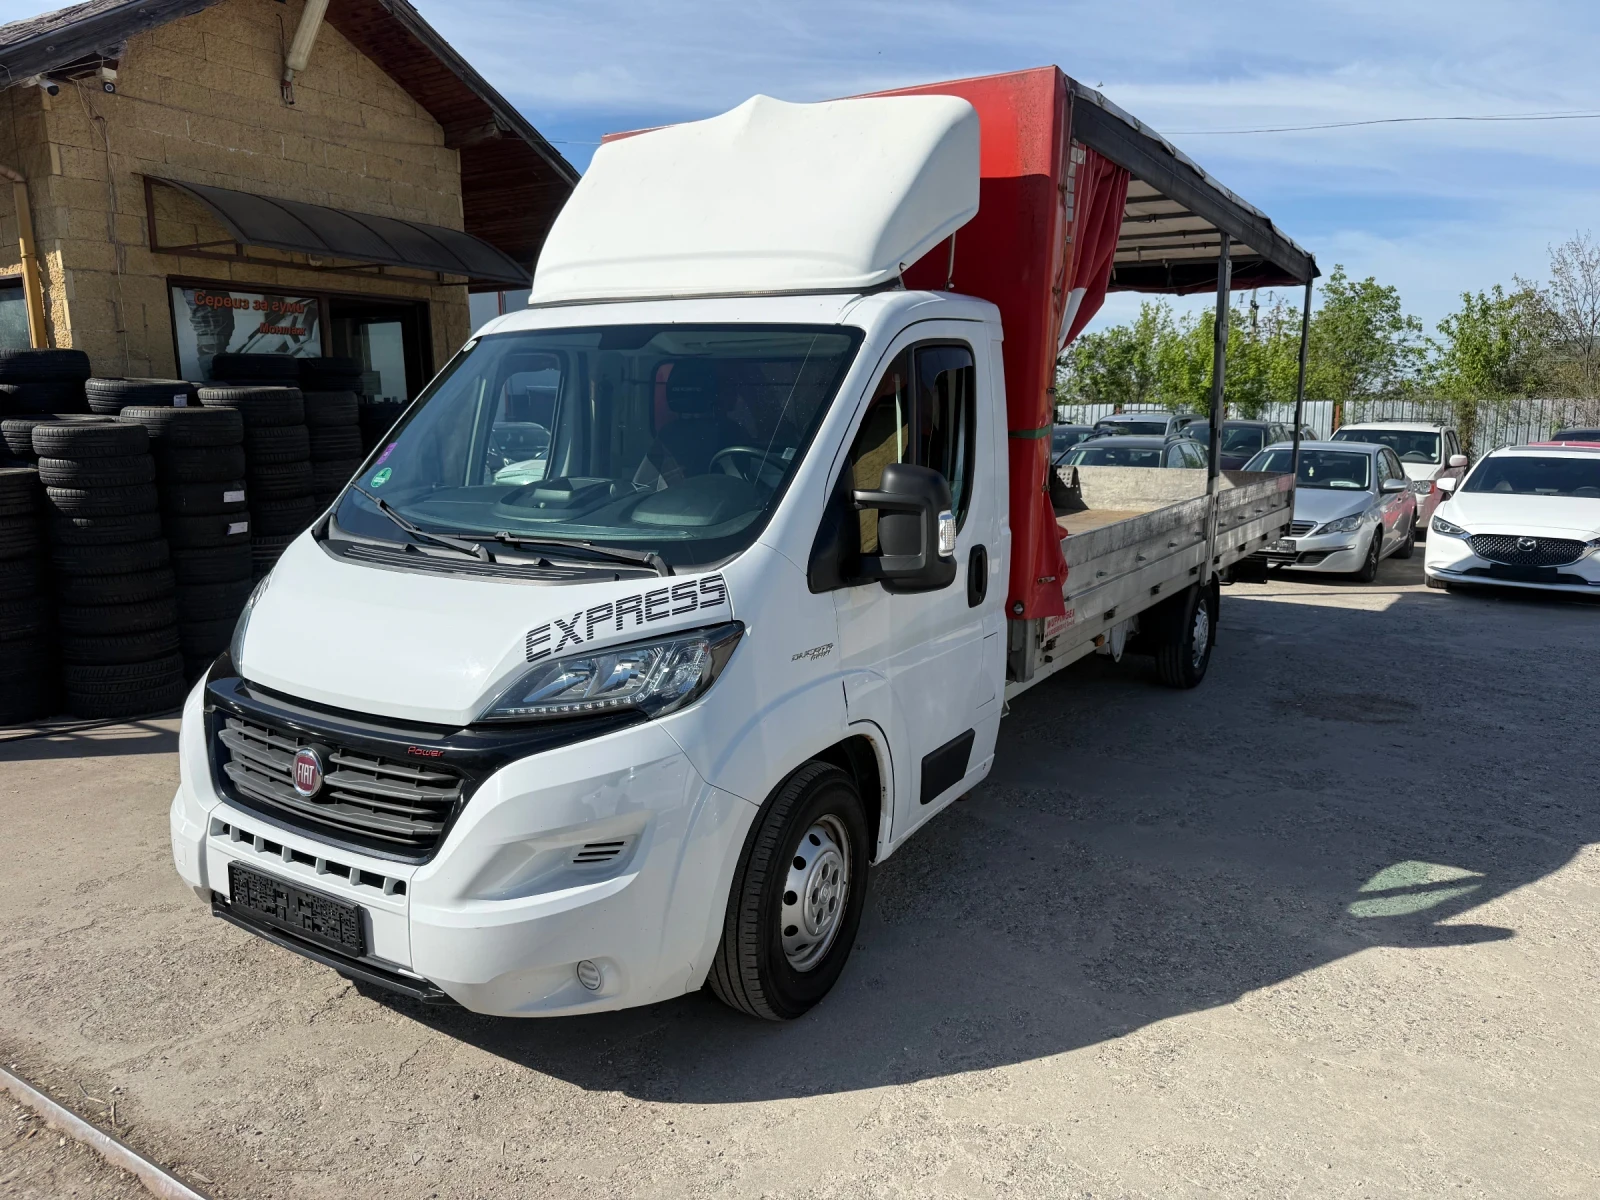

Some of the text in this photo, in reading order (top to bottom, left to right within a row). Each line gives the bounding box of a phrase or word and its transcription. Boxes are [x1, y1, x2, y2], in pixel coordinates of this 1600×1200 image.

[194, 291, 305, 314] Сервиз за гуми
[259, 322, 306, 336] Монтаж
[525, 575, 725, 663] EXPRESS
[407, 746, 444, 757] Power
[297, 762, 314, 785] FIAT
